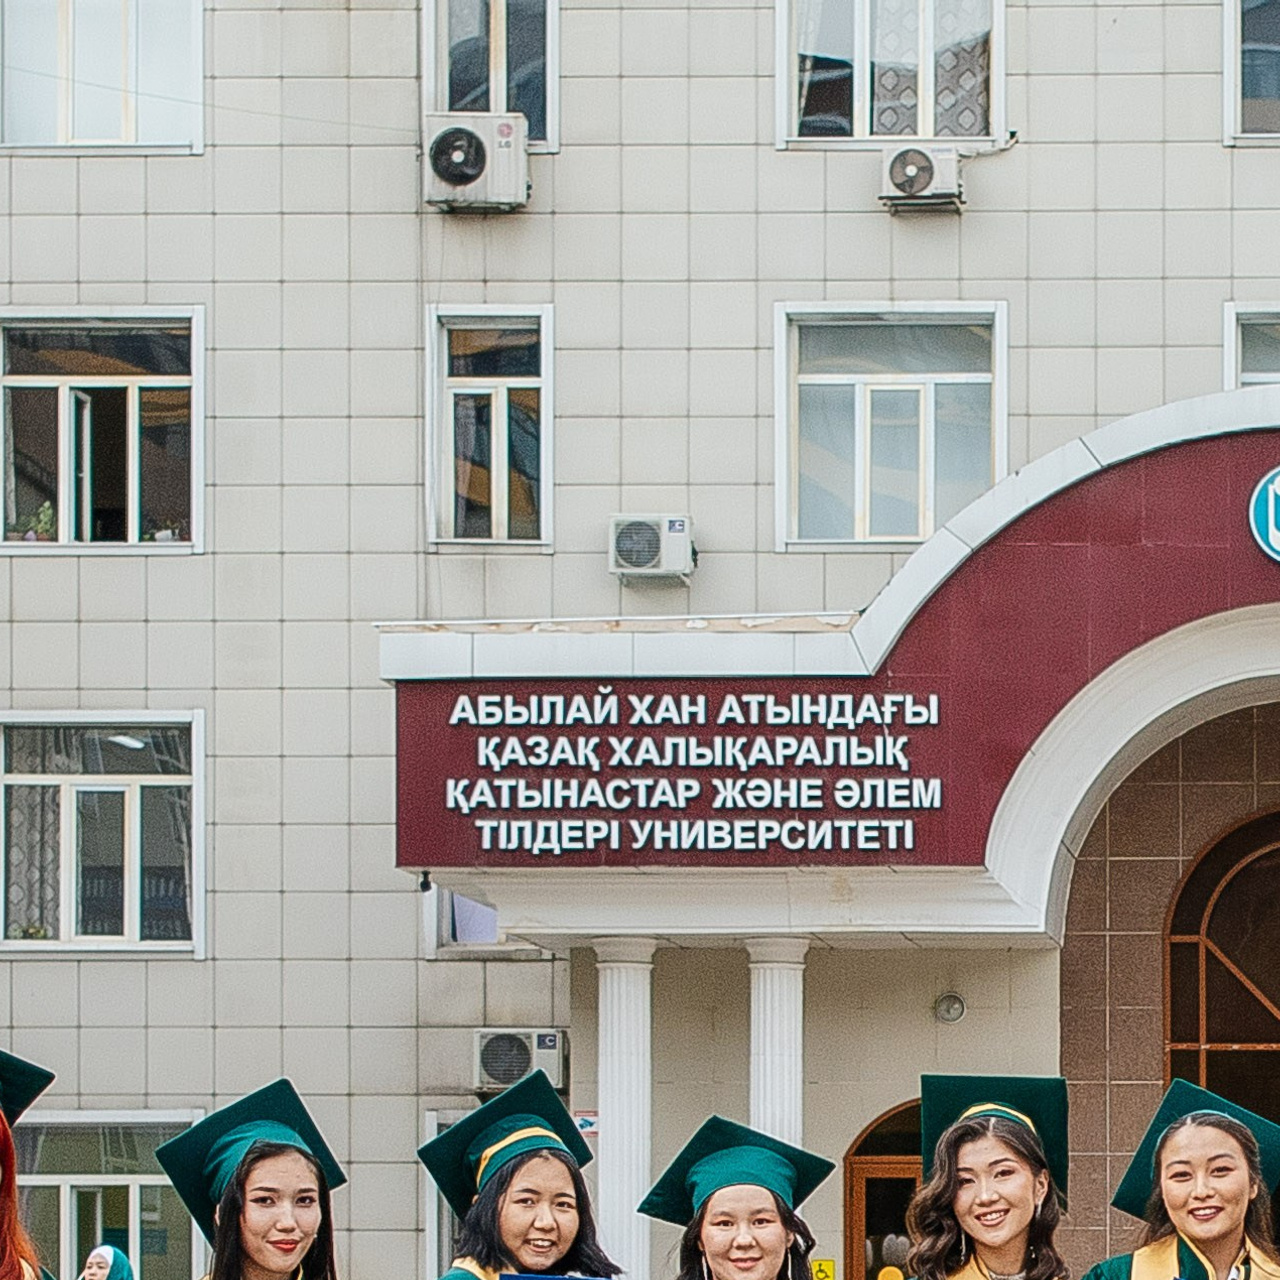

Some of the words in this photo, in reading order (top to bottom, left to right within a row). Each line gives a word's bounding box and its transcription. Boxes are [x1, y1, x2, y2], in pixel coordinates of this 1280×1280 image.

[449, 686, 618, 724] АБЫЛАЙ
[628, 695, 706, 724] ХАН
[716, 694, 939, 728] АТЫНДАҒЫ
[477, 737, 600, 771] ҚАЗАҚ
[608, 737, 909, 771] ХАЛЫҚАРАЛЫҚ
[446, 778, 700, 813] ҚАТЫНАСТАР
[712, 778, 824, 809] ЖӘНЕ
[834, 778, 941, 809] ӘЛЕМ
[475, 819, 619, 855] ТІЛДЕРІ
[629, 820, 914, 850] УНИВЕРСИТЕТІ
